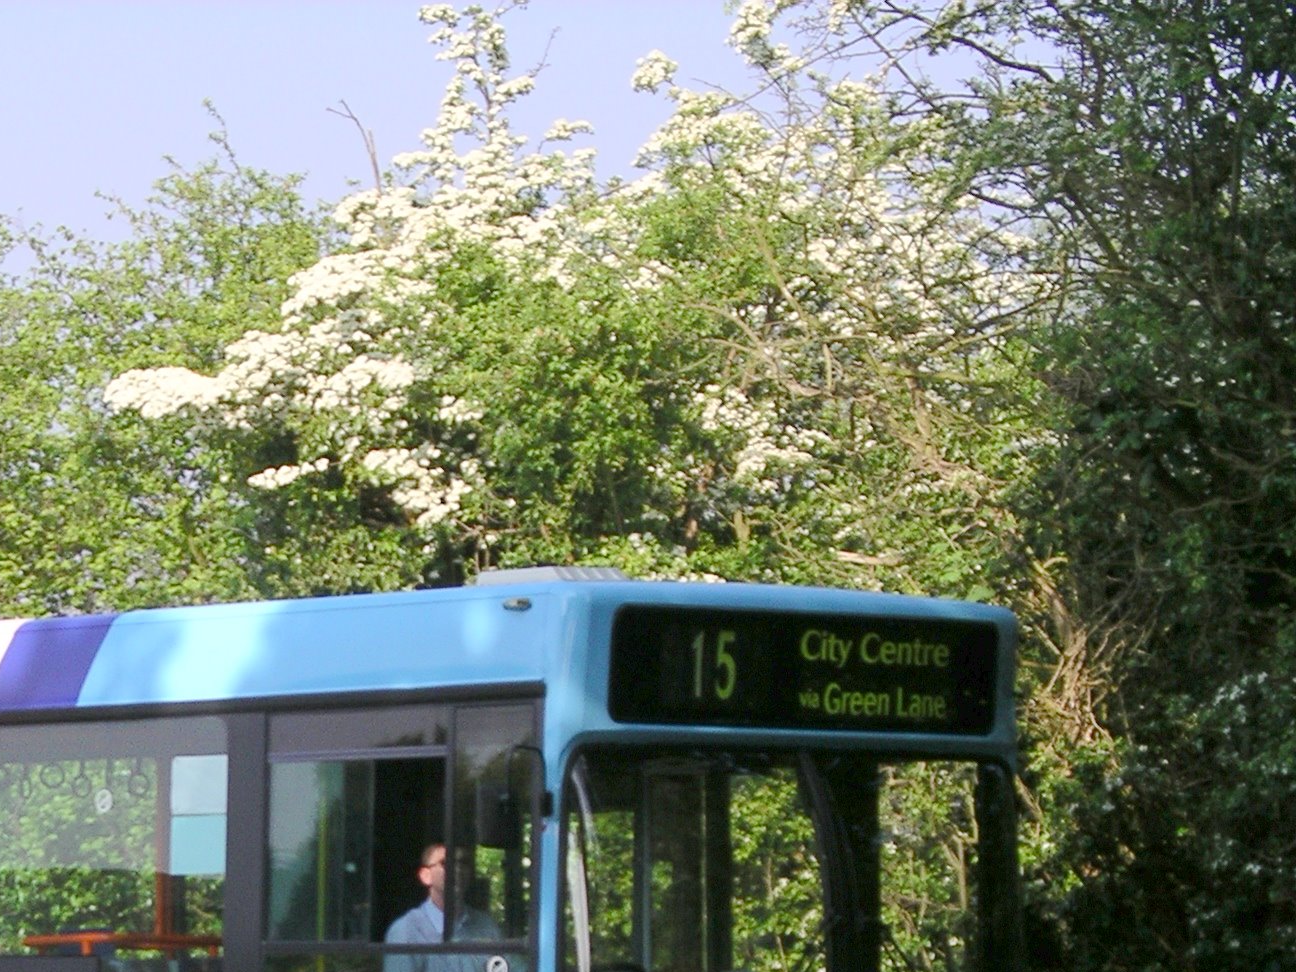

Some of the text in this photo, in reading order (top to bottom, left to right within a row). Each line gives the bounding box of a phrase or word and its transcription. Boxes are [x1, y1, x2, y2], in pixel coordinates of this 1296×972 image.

[692, 629, 736, 699] 15
[801, 629, 950, 668] City Centre
[801, 682, 947, 719] via Green Lane
